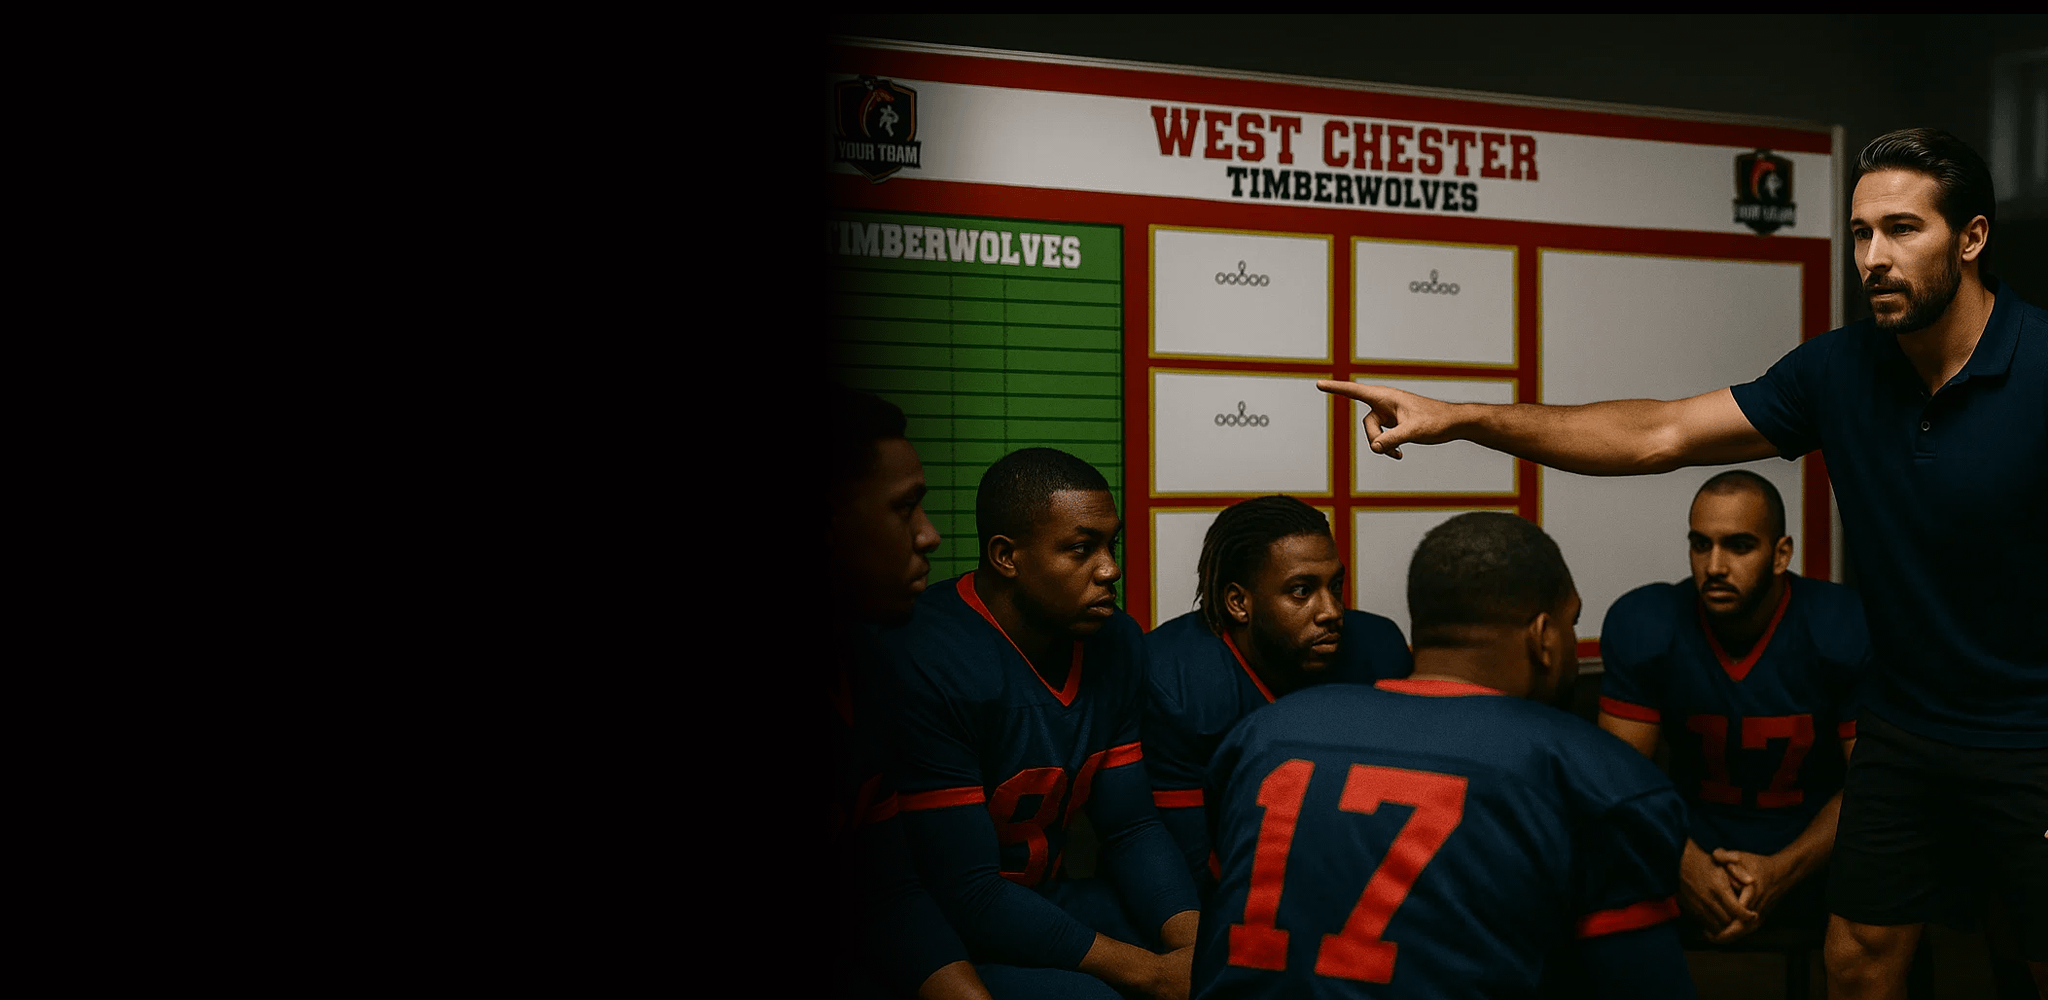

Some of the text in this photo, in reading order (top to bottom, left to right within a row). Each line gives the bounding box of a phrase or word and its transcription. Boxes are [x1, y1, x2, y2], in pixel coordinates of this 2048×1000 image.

[838, 140, 875, 161] YOUR
[1151, 106, 1539, 181] WEST CHESTER
[1227, 167, 1478, 212] TIMBERWOLVES
[1682, 713, 1816, 810] 17
[1227, 758, 1469, 985] 17
